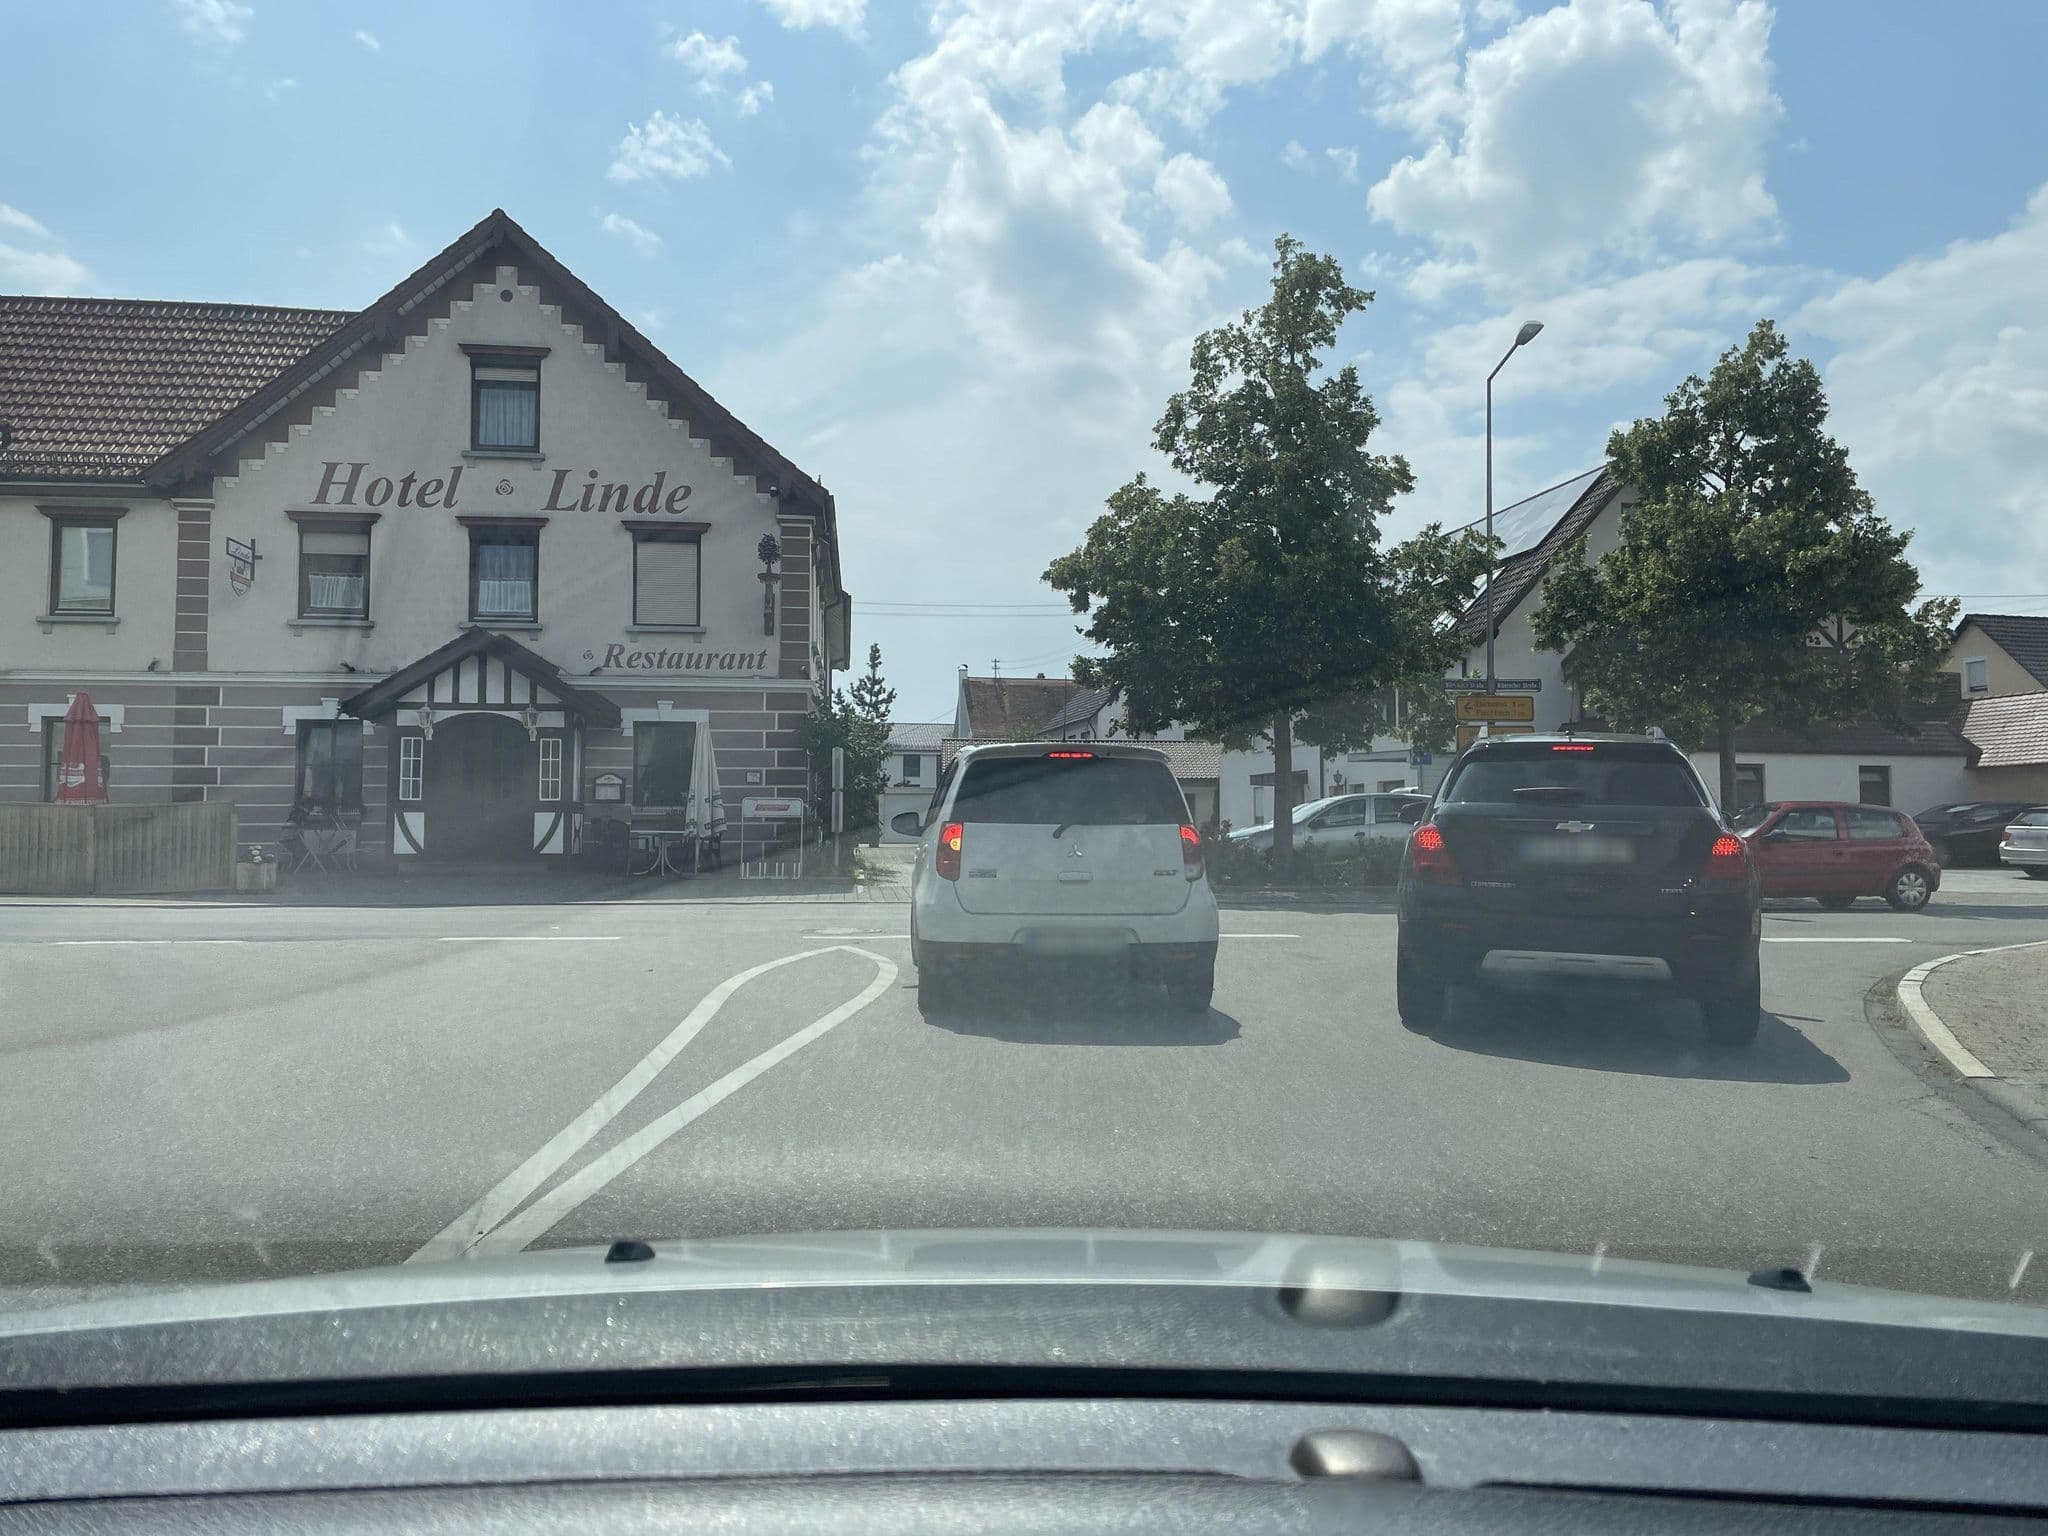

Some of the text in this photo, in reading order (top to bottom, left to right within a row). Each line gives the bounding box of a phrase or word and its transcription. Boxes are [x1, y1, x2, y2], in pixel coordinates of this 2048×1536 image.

[309, 461, 692, 514] Hotel Linde
[602, 643, 768, 671] Restaurant
